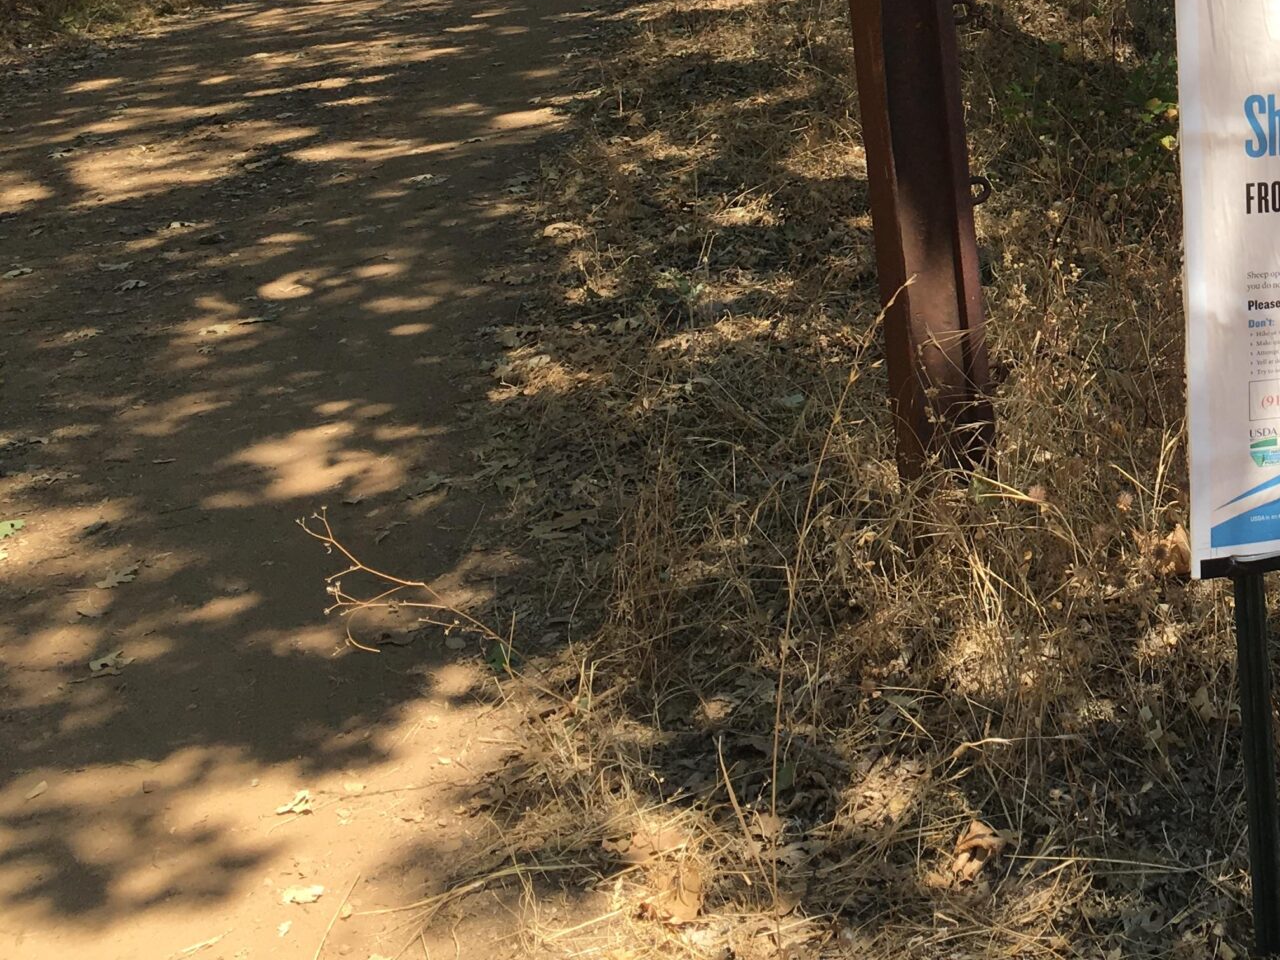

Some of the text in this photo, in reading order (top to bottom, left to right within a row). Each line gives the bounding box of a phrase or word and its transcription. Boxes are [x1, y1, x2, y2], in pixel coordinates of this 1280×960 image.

[1247, 271, 1269, 280] Sheep
[1247, 283, 1260, 292] you
[1248, 318, 1275, 328] Don't:
[1250, 428, 1278, 438] USDA
